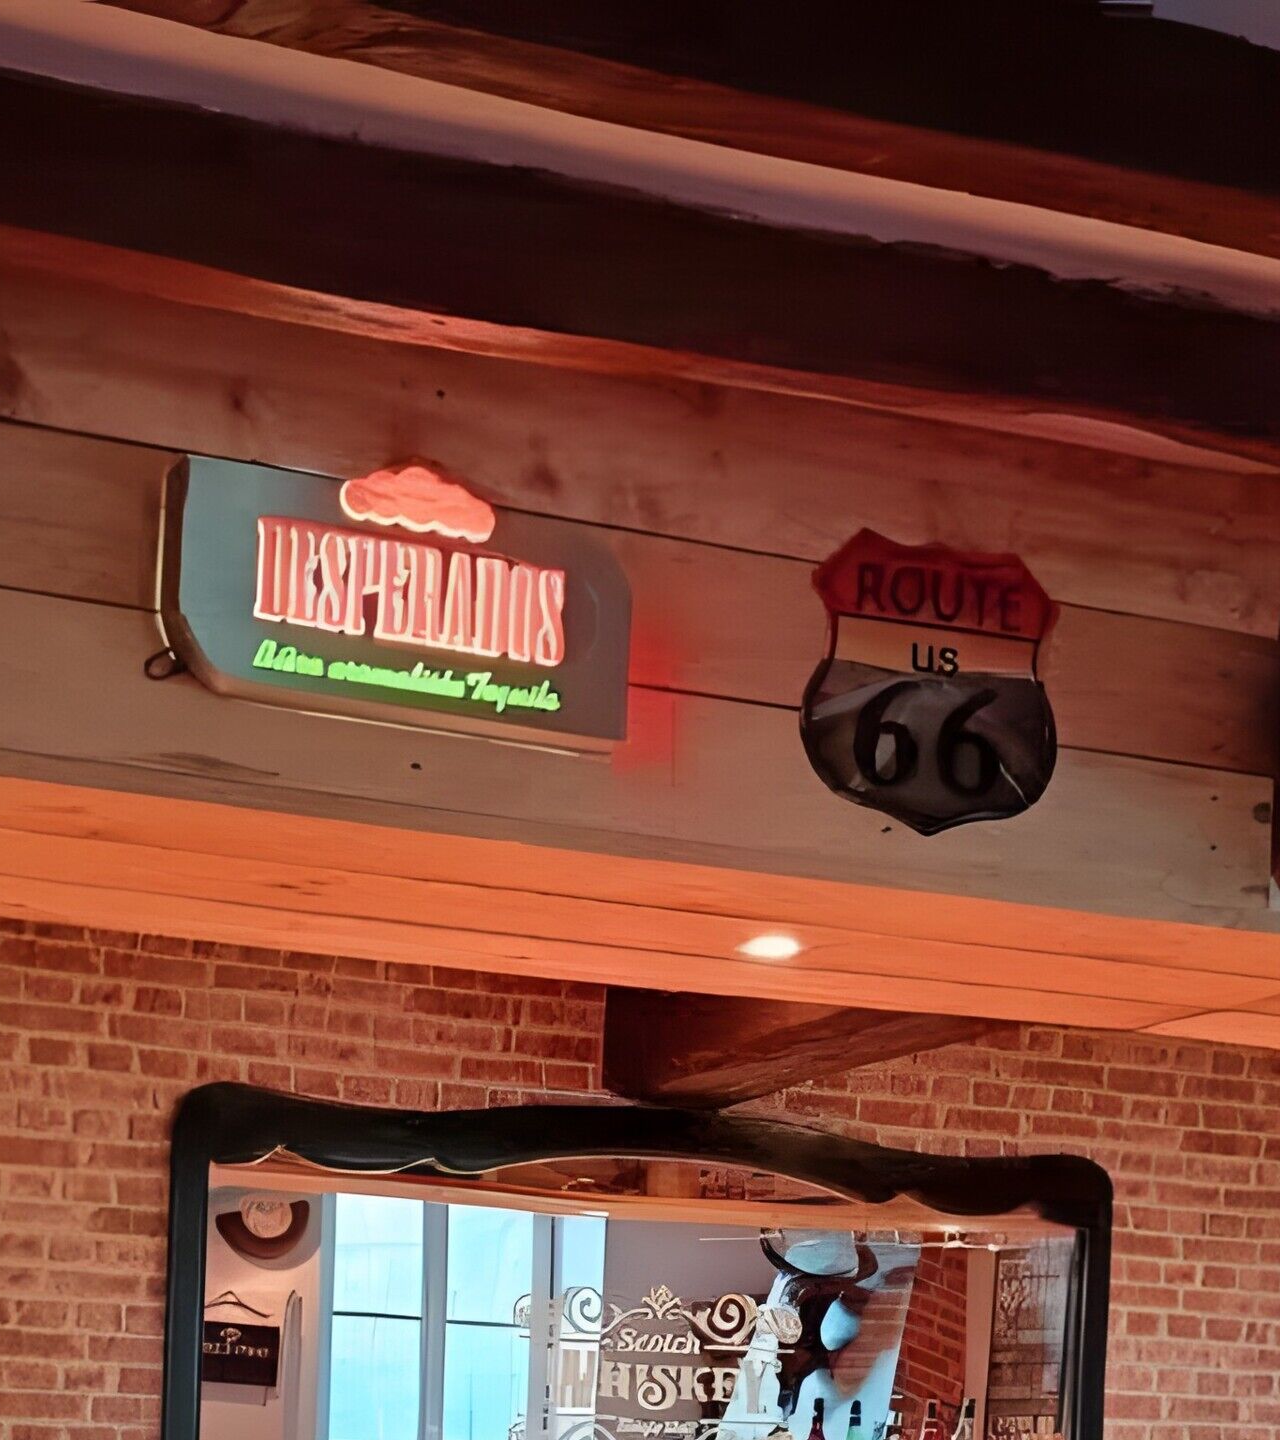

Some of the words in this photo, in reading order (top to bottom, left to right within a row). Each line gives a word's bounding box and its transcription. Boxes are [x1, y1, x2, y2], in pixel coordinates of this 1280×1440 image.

[855, 563, 1022, 632] ROUTE
[911, 641, 959, 678] US
[852, 679, 1000, 797] 66
